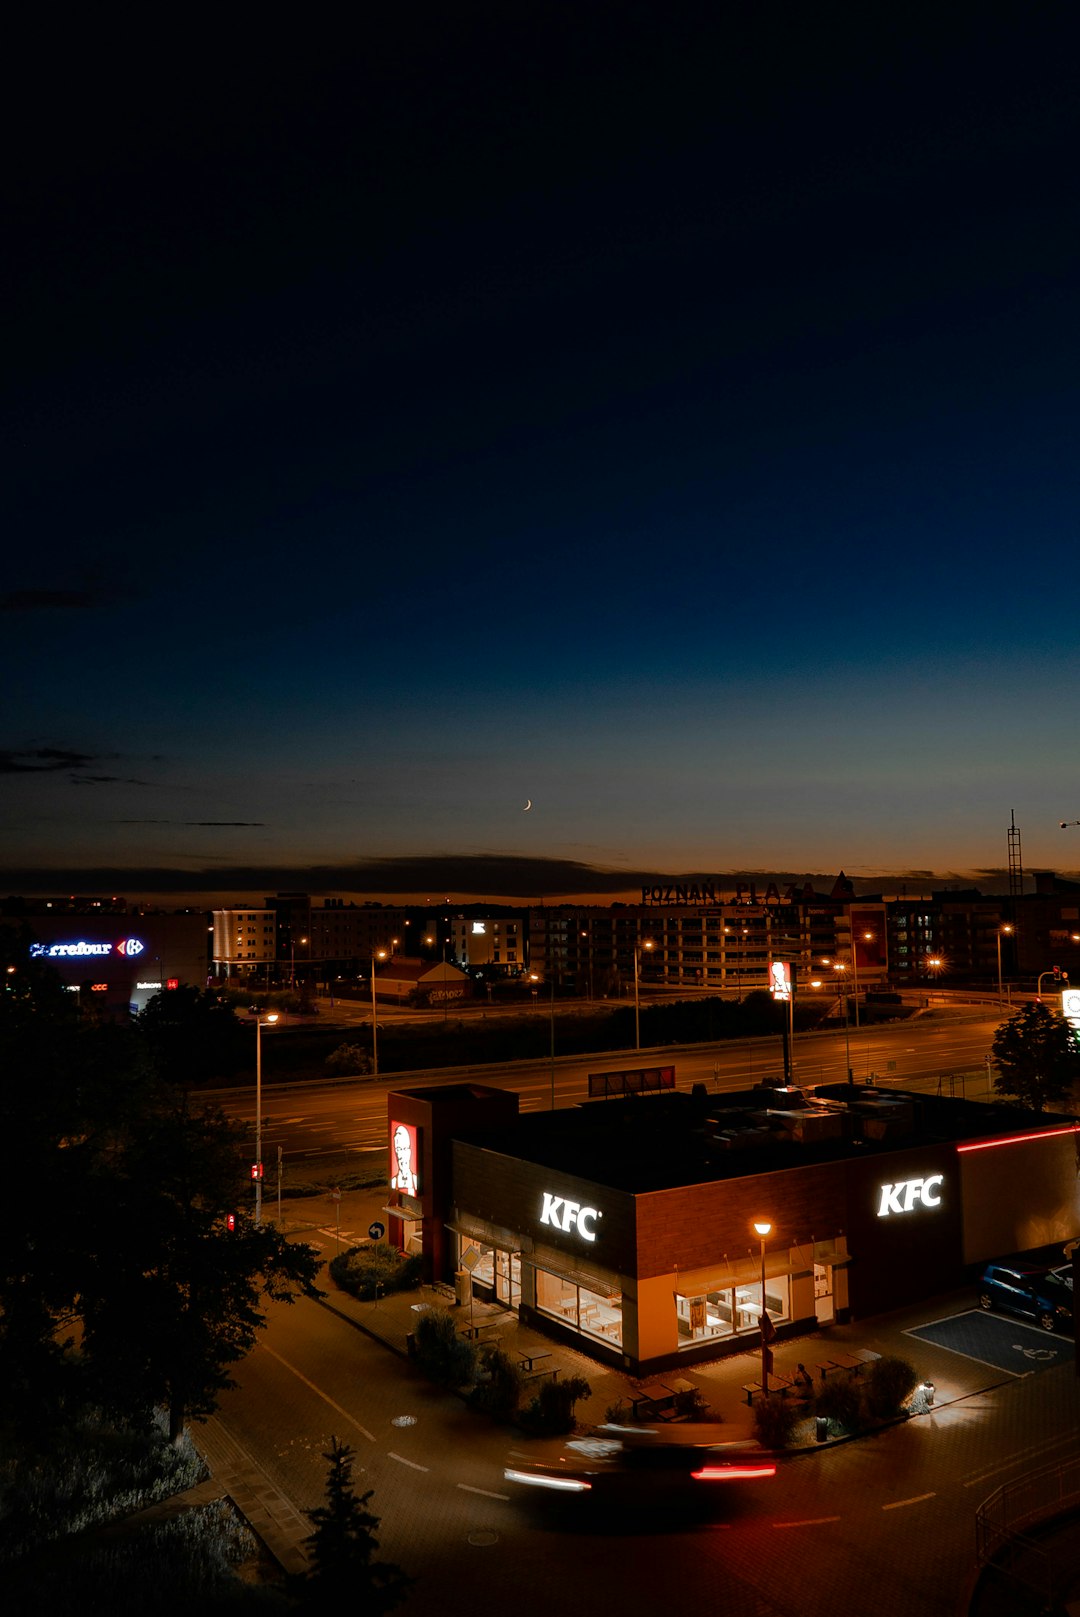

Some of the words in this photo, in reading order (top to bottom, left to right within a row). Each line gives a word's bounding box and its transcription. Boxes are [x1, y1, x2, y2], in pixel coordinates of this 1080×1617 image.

[642, 877, 716, 901] POZNAŃ
[736, 882, 814, 900] PLAZA
[30, 941, 112, 957] Crrefour
[91, 983, 108, 991] CCC
[877, 1174, 943, 1217] KFC
[540, 1192, 599, 1242] KFC
